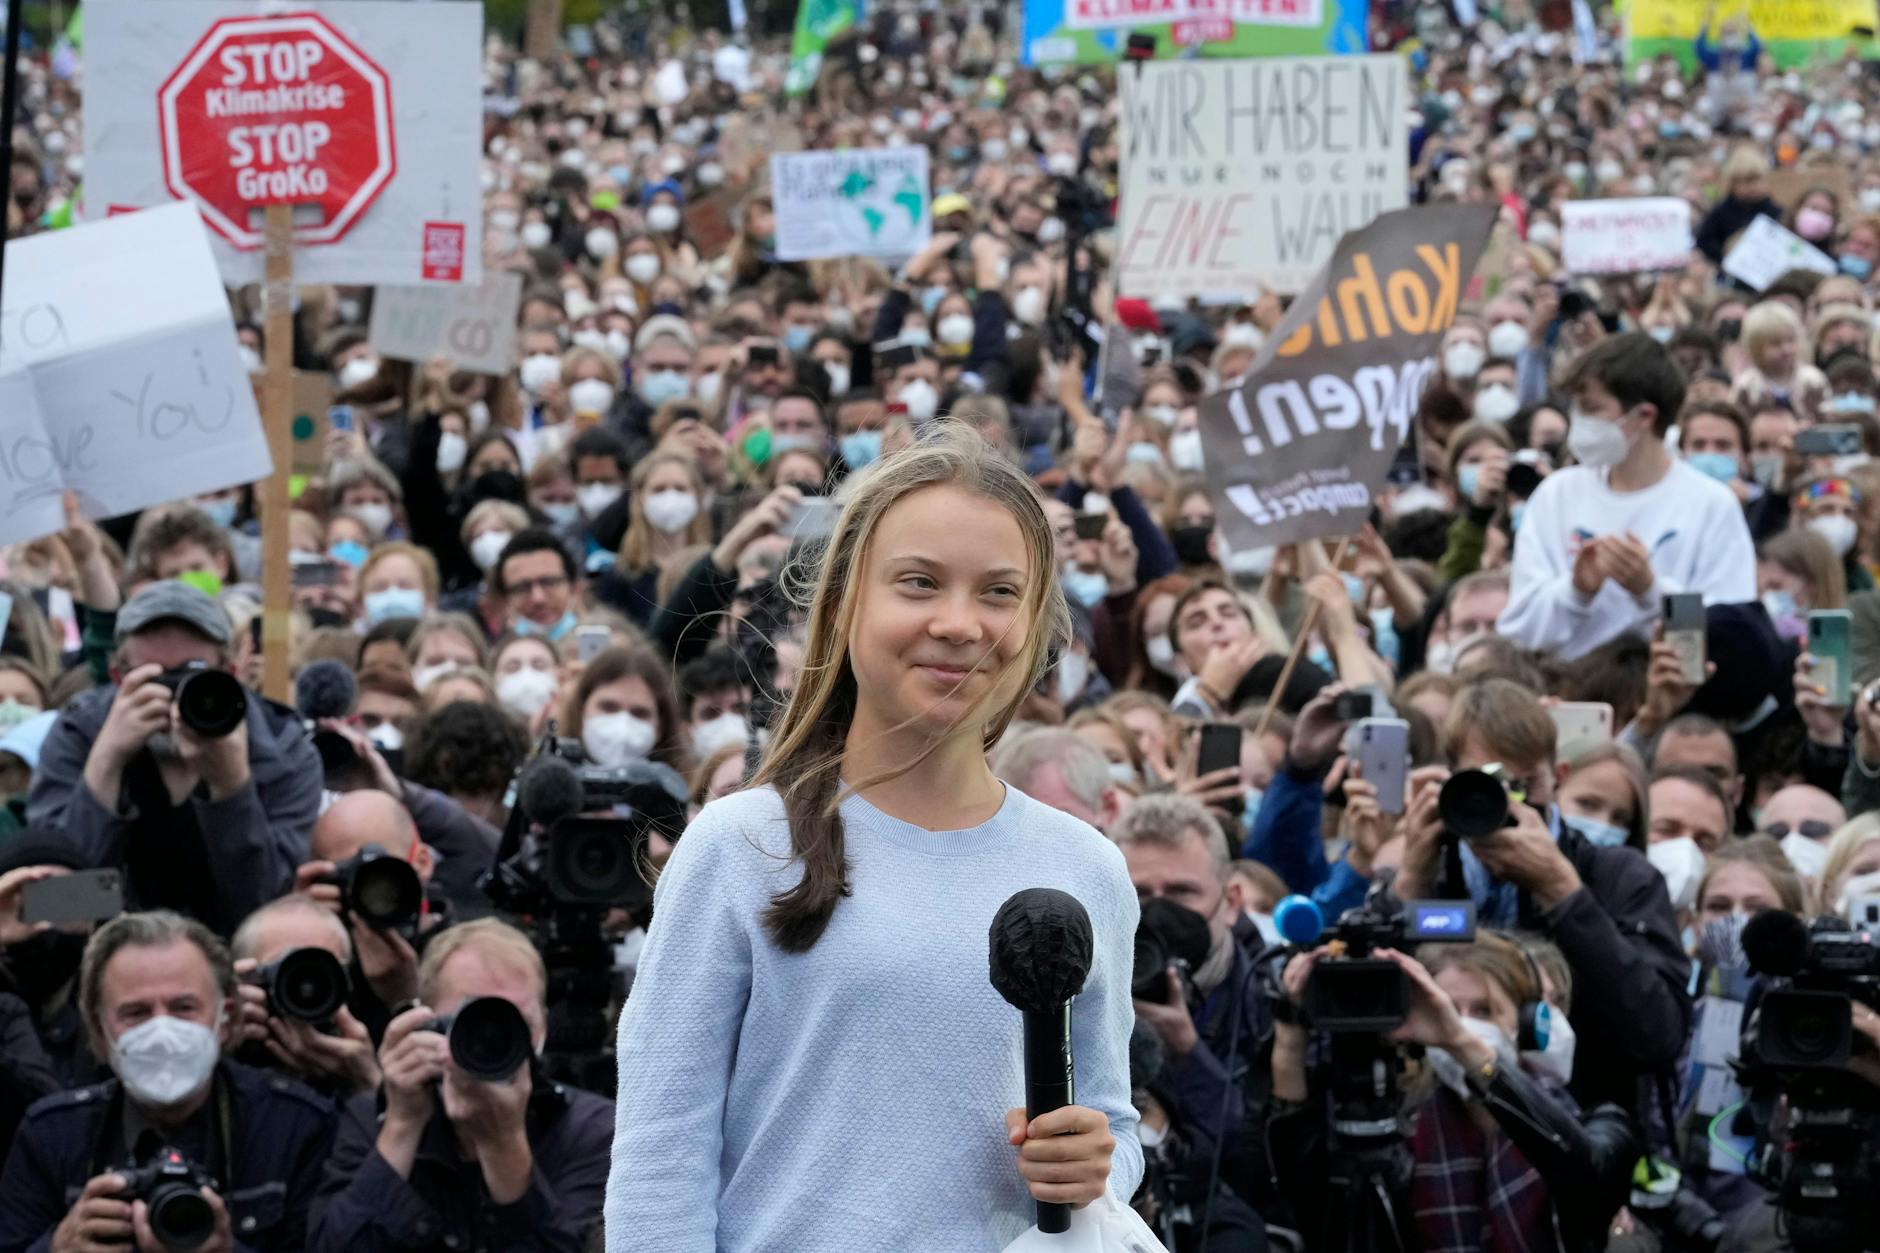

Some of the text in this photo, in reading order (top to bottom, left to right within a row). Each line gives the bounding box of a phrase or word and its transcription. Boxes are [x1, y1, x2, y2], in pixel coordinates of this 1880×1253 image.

[219, 40, 324, 87] STOP
[205, 81, 345, 118] Klimakrise
[1119, 61, 1396, 158] WIR HABEN
[227, 121, 331, 167] STOP
[235, 164, 328, 200] GroKo
[1261, 161, 1387, 184] NOCH
[1116, 192, 1382, 271] EINE WA
